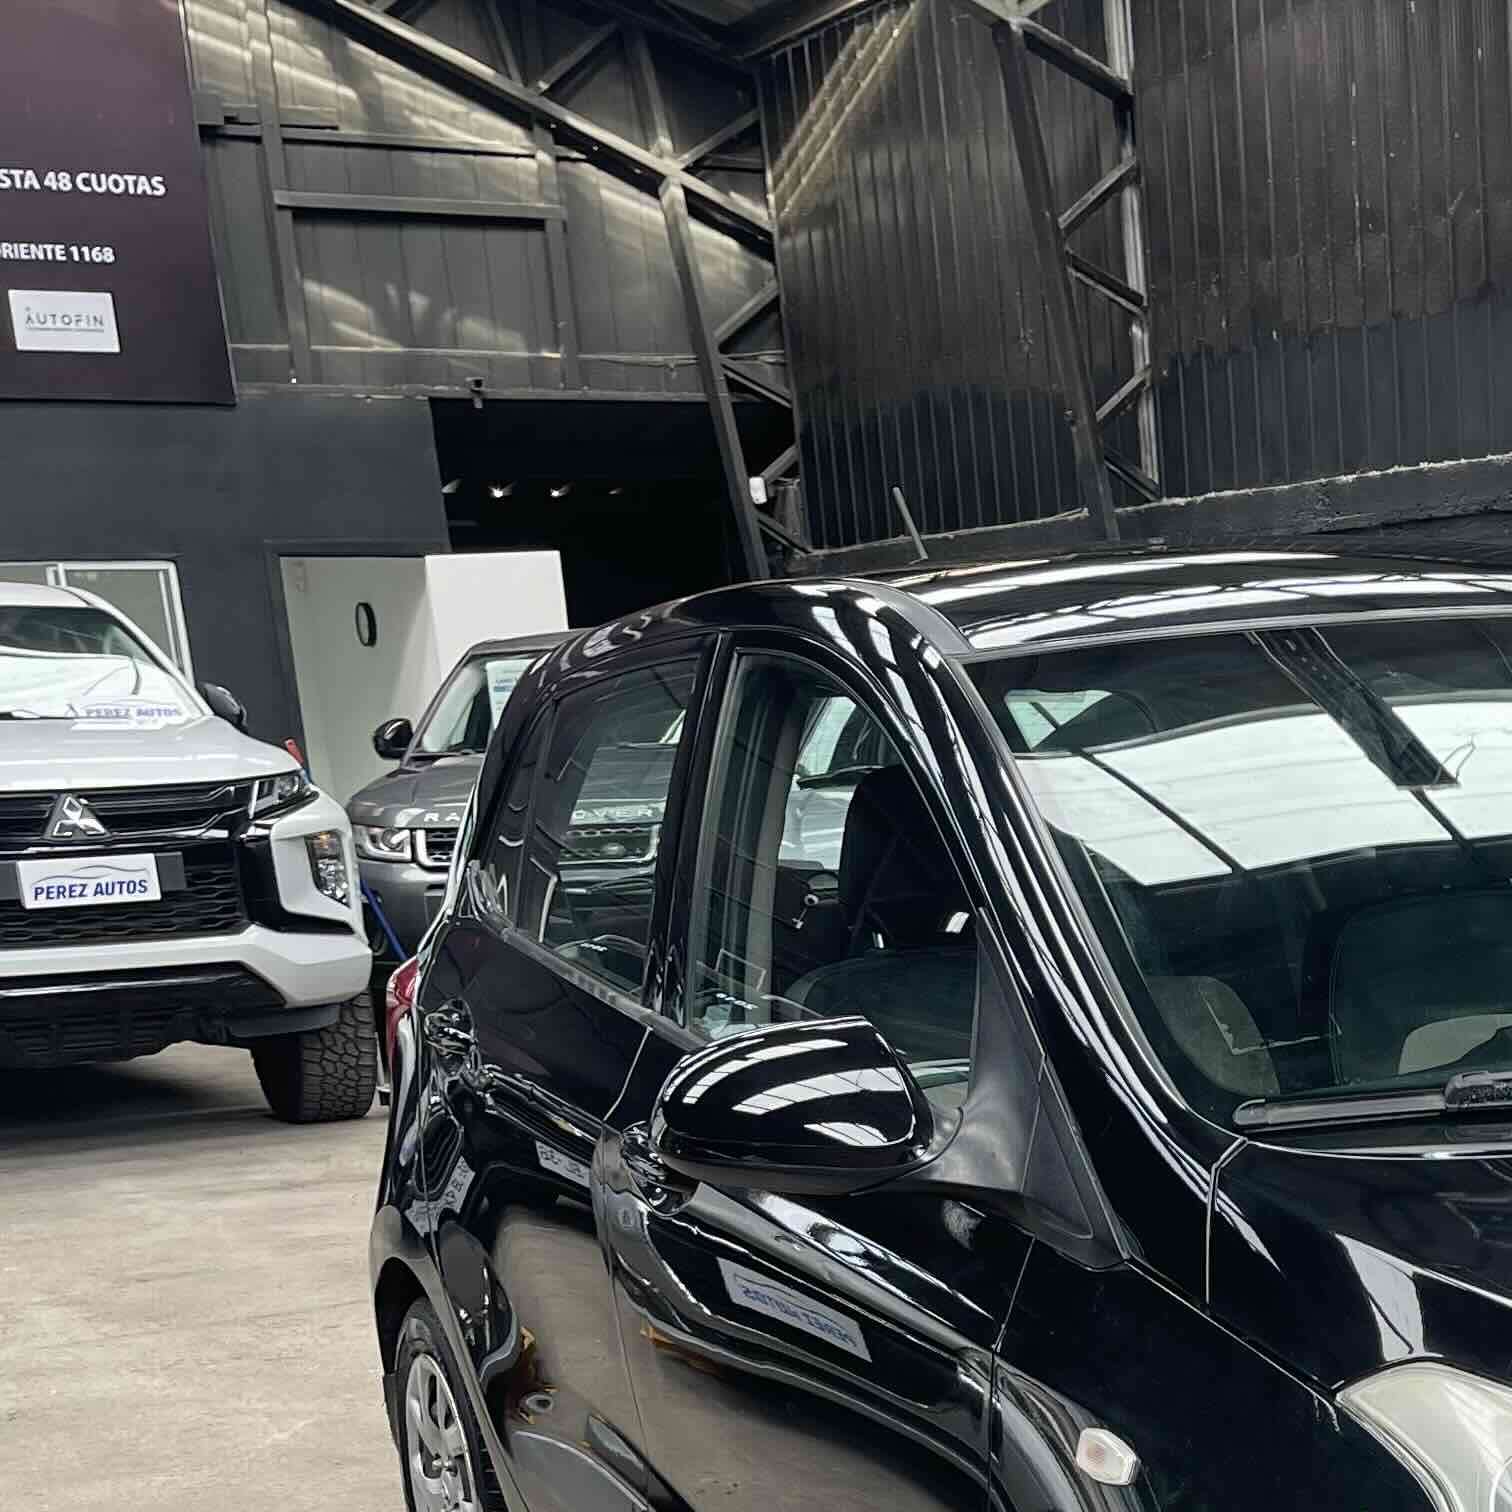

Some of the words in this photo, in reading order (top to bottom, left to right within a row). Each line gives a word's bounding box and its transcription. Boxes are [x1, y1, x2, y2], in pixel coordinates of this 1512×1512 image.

[44, 172, 73, 191] 48
[75, 172, 166, 196] CUOTAS
[0, 242, 67, 261] RIENTE
[69, 246, 115, 262] 1168
[25, 306, 104, 327] AUTOFIN
[34, 884, 88, 900] PEREZ
[93, 879, 148, 897] AUTOS
